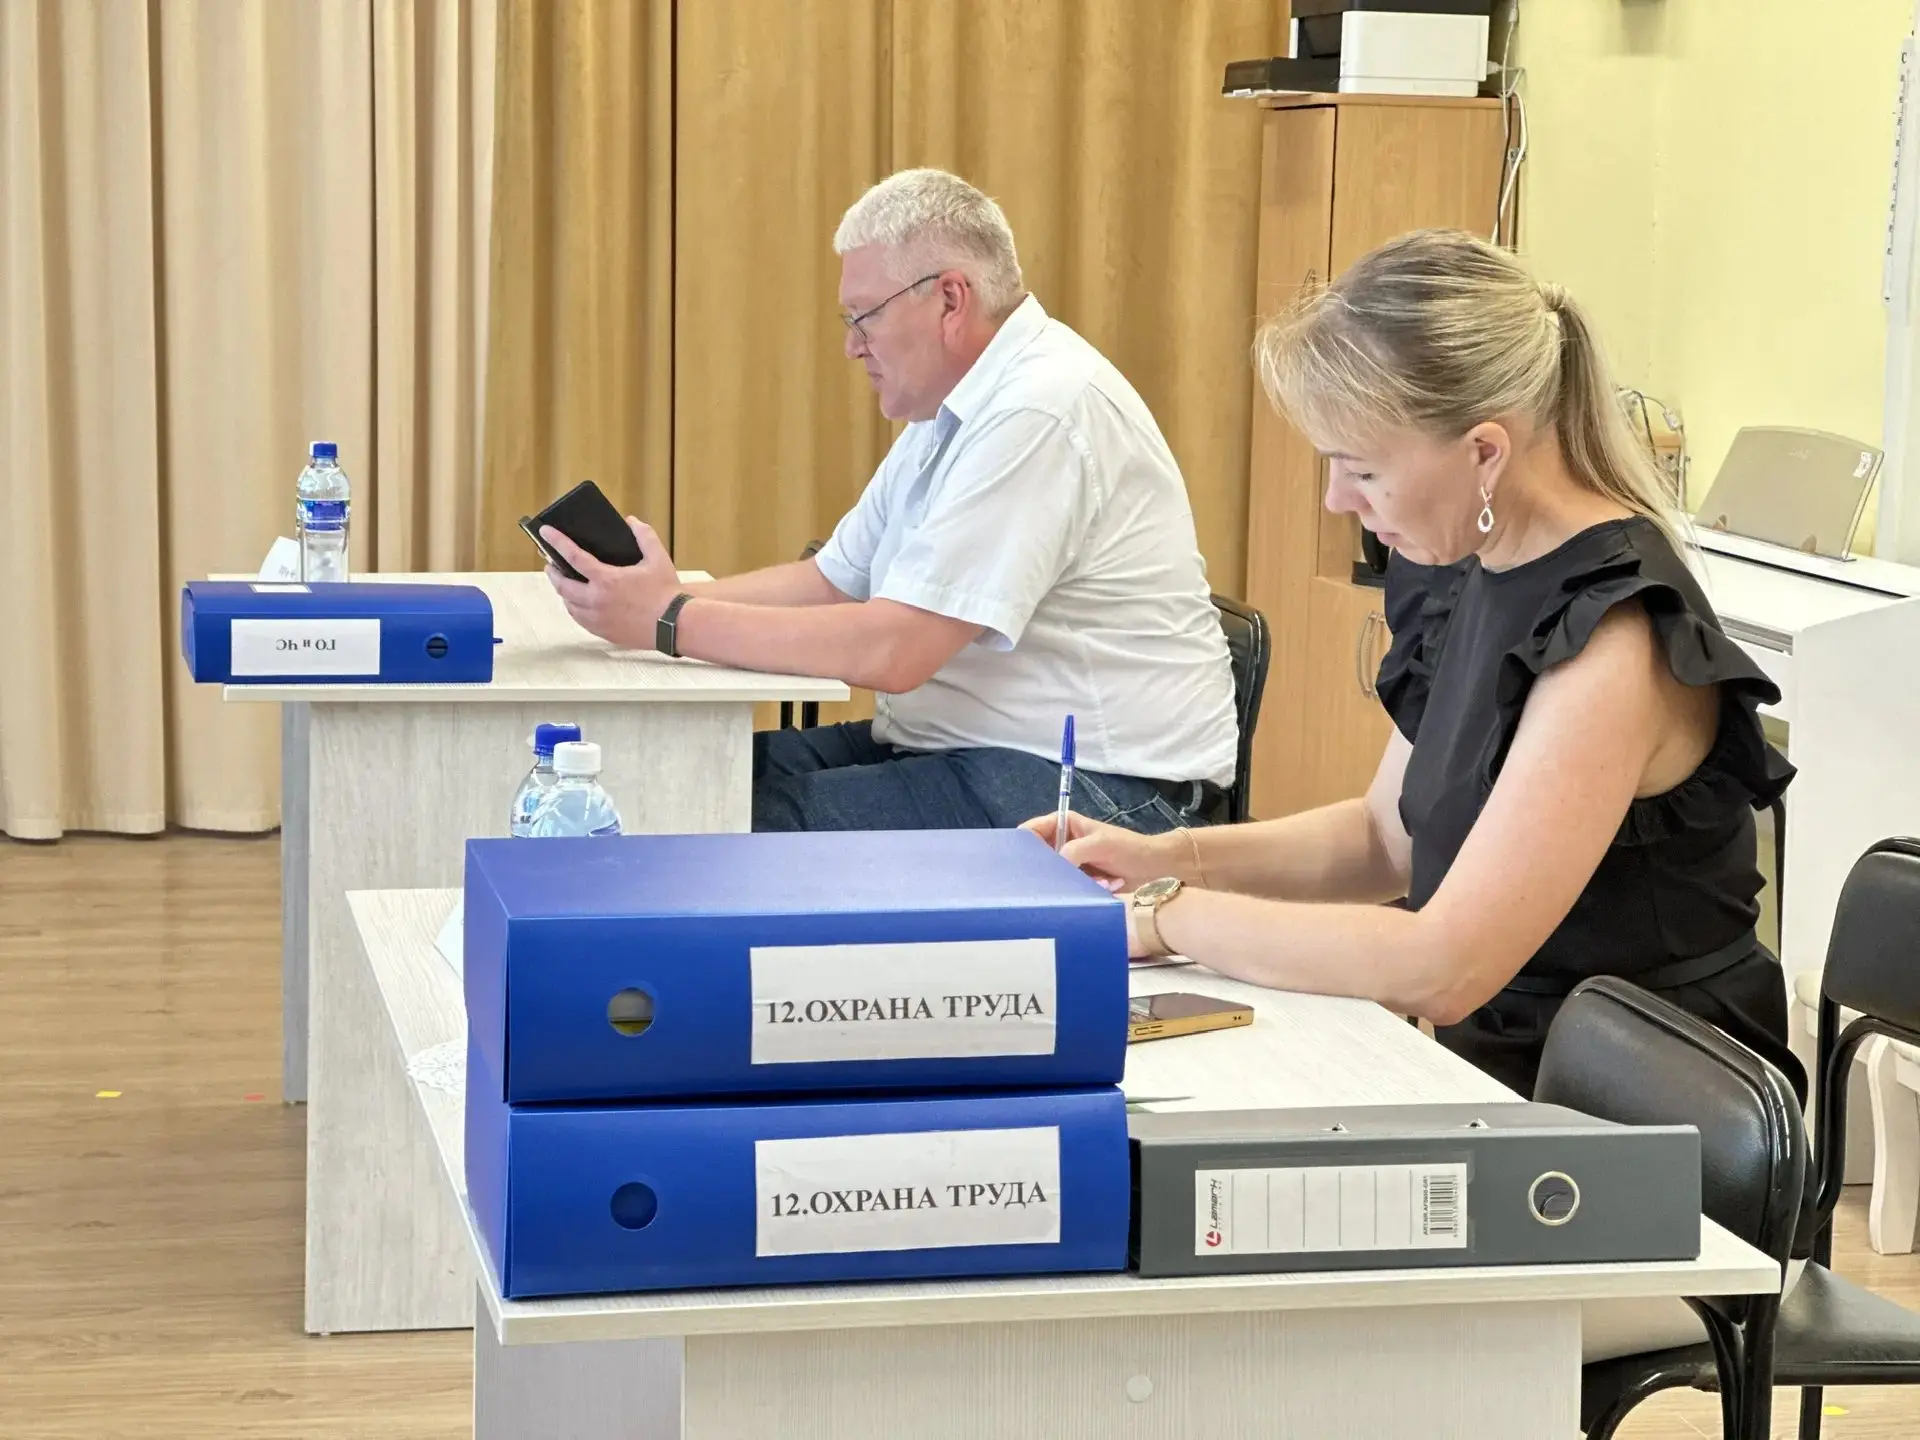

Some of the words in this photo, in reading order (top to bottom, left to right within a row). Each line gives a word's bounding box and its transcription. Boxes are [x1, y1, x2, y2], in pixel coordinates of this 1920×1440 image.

[275, 639, 298, 651] ЧС
[315, 639, 337, 651] ГО
[767, 997, 934, 1024] 12.ОХРАНА
[942, 993, 1044, 1021] ТРУДА
[771, 1187, 938, 1217] 12.ОХРАНА
[946, 1181, 1047, 1209] ТРУДА
